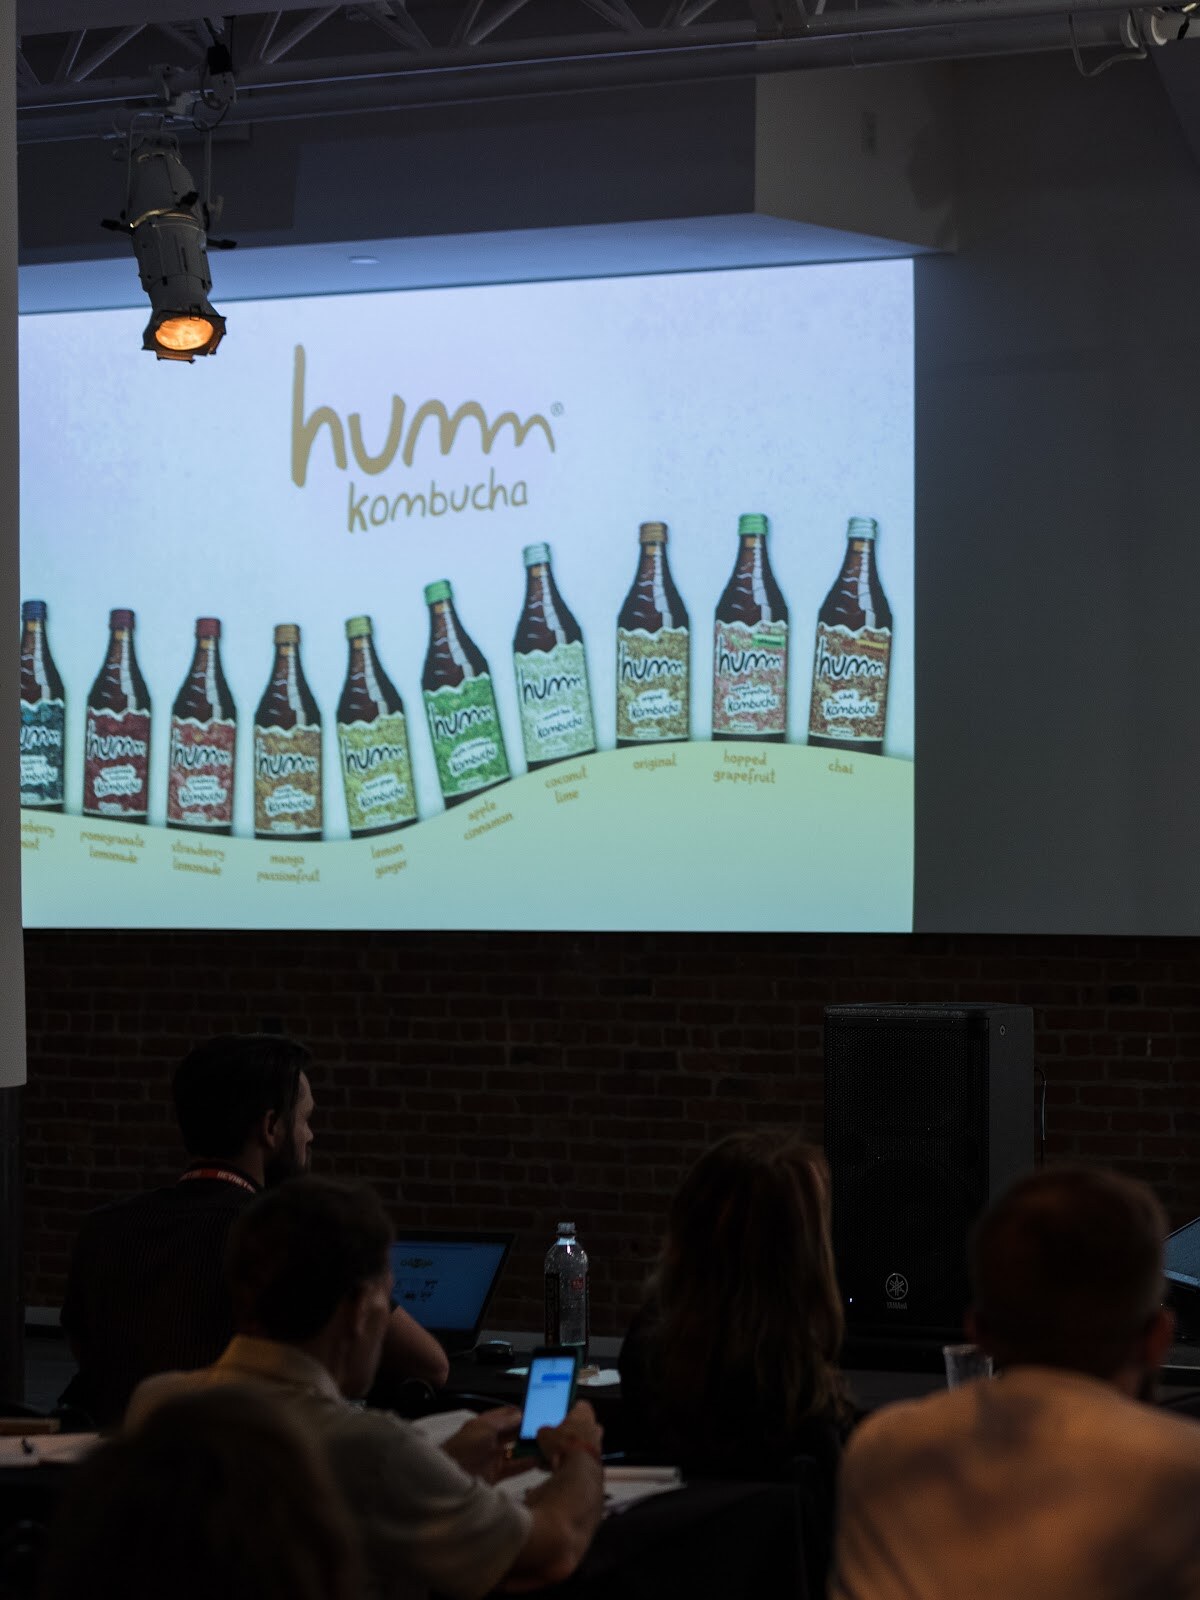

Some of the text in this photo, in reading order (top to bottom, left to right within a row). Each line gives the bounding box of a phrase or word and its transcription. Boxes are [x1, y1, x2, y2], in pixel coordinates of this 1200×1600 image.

[348, 466, 528, 533] kombucha
[718, 635, 782, 674] humm
[819, 638, 883, 677] humm
[727, 698, 776, 713] kombucha
[825, 701, 876, 716] kombucha
[633, 753, 677, 771] original
[723, 749, 767, 767] hopped
[828, 757, 854, 774] chai
[545, 765, 588, 788] coconut
[713, 768, 776, 785] grapefruit
[555, 789, 579, 804] lime
